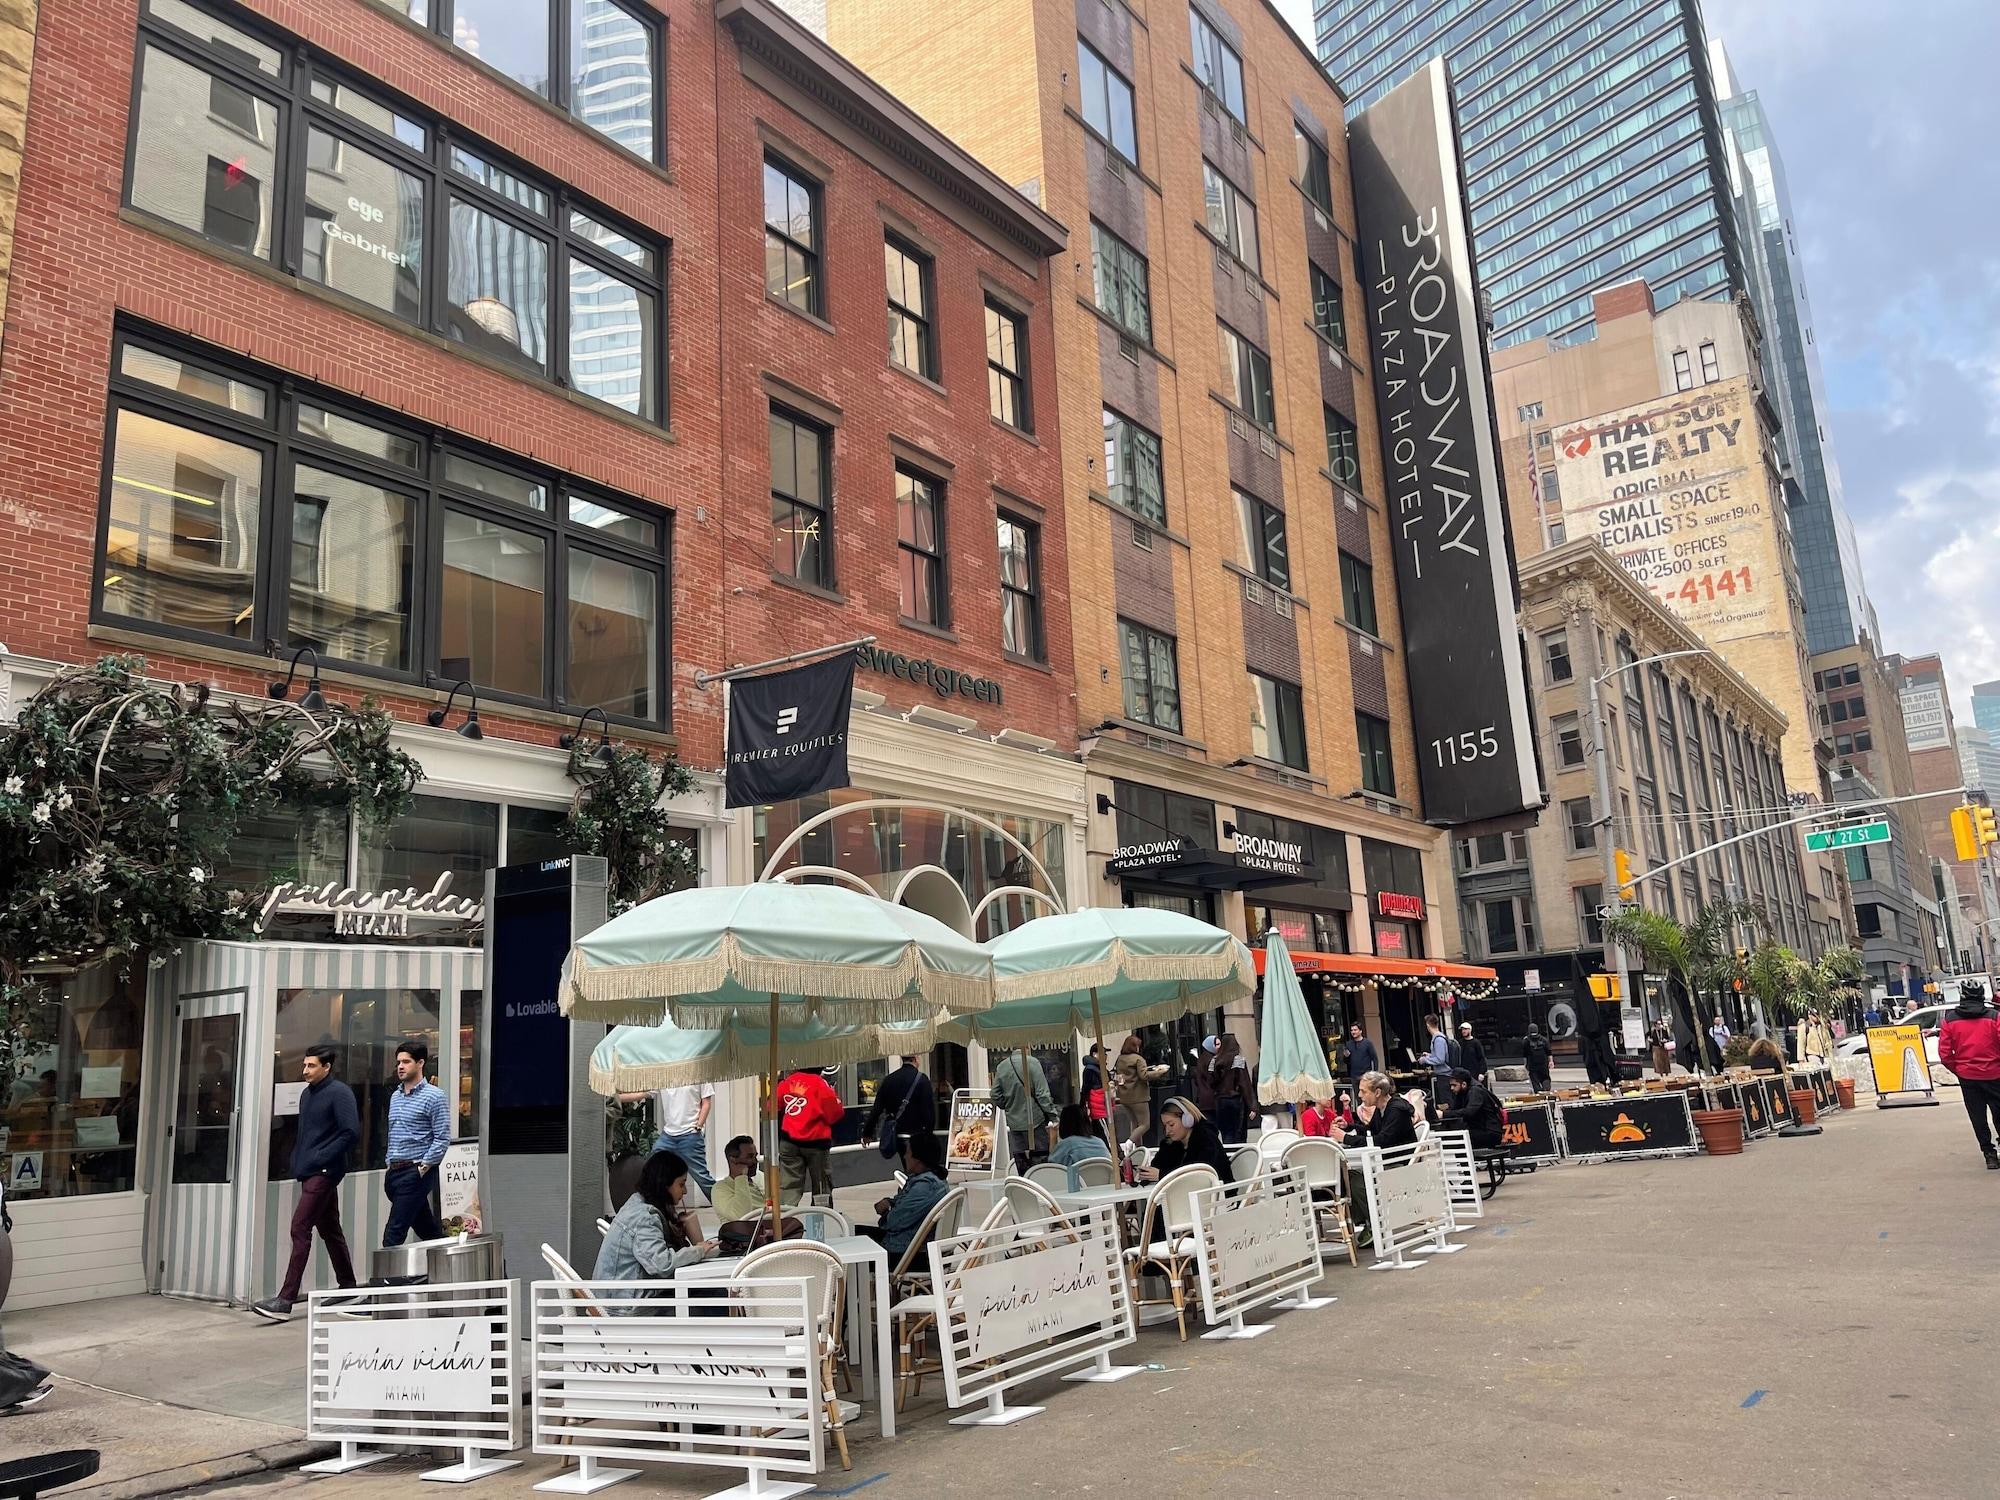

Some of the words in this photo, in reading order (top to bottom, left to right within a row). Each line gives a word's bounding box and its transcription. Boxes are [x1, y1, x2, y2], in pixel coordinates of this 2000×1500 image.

[348, 196, 383, 223] ege
[322, 220, 406, 268] Gabriel
[1376, 276, 1407, 398] PLAZA
[1402, 206, 1479, 557] BROADWAY
[1602, 418, 1742, 478] REALTY
[1391, 410, 1423, 539] HOTEL
[1599, 499, 1662, 527] SMALL
[1670, 482, 1731, 511] SPACE
[1600, 511, 1698, 547] ECIALISTS
[1705, 513, 1731, 525] SINCE
[1674, 535, 1728, 557] OFFICES
[1646, 566, 1753, 604] -4141
[856, 645, 1002, 705] sweetgreen
[785, 733, 843, 756] EQUITIES
[1431, 726, 1499, 768] 1155
[1235, 834, 1302, 863] BROADWAY
[1825, 834, 1835, 846] W
[1840, 831, 1853, 844] 27
[1858, 828, 1870, 841] St
[1113, 839, 1181, 860] BROADWAY
[1118, 856, 1145, 869] PLAZA
[1149, 853, 1177, 865] HOTEL
[540, 858, 571, 872] LinkNYC
[1246, 858, 1271, 870] PLAZA
[1273, 862, 1297, 874] HOTEL
[335, 911, 408, 936] MIAMI
[517, 999, 557, 1017] Lovable
[958, 1103, 993, 1117] WRAPS
[16, 1157, 36, 1180] A
[447, 1171, 476, 1183] FALA
[1026, 1311, 1064, 1335] MIAMI
[385, 1384, 425, 1401] MIAMI
